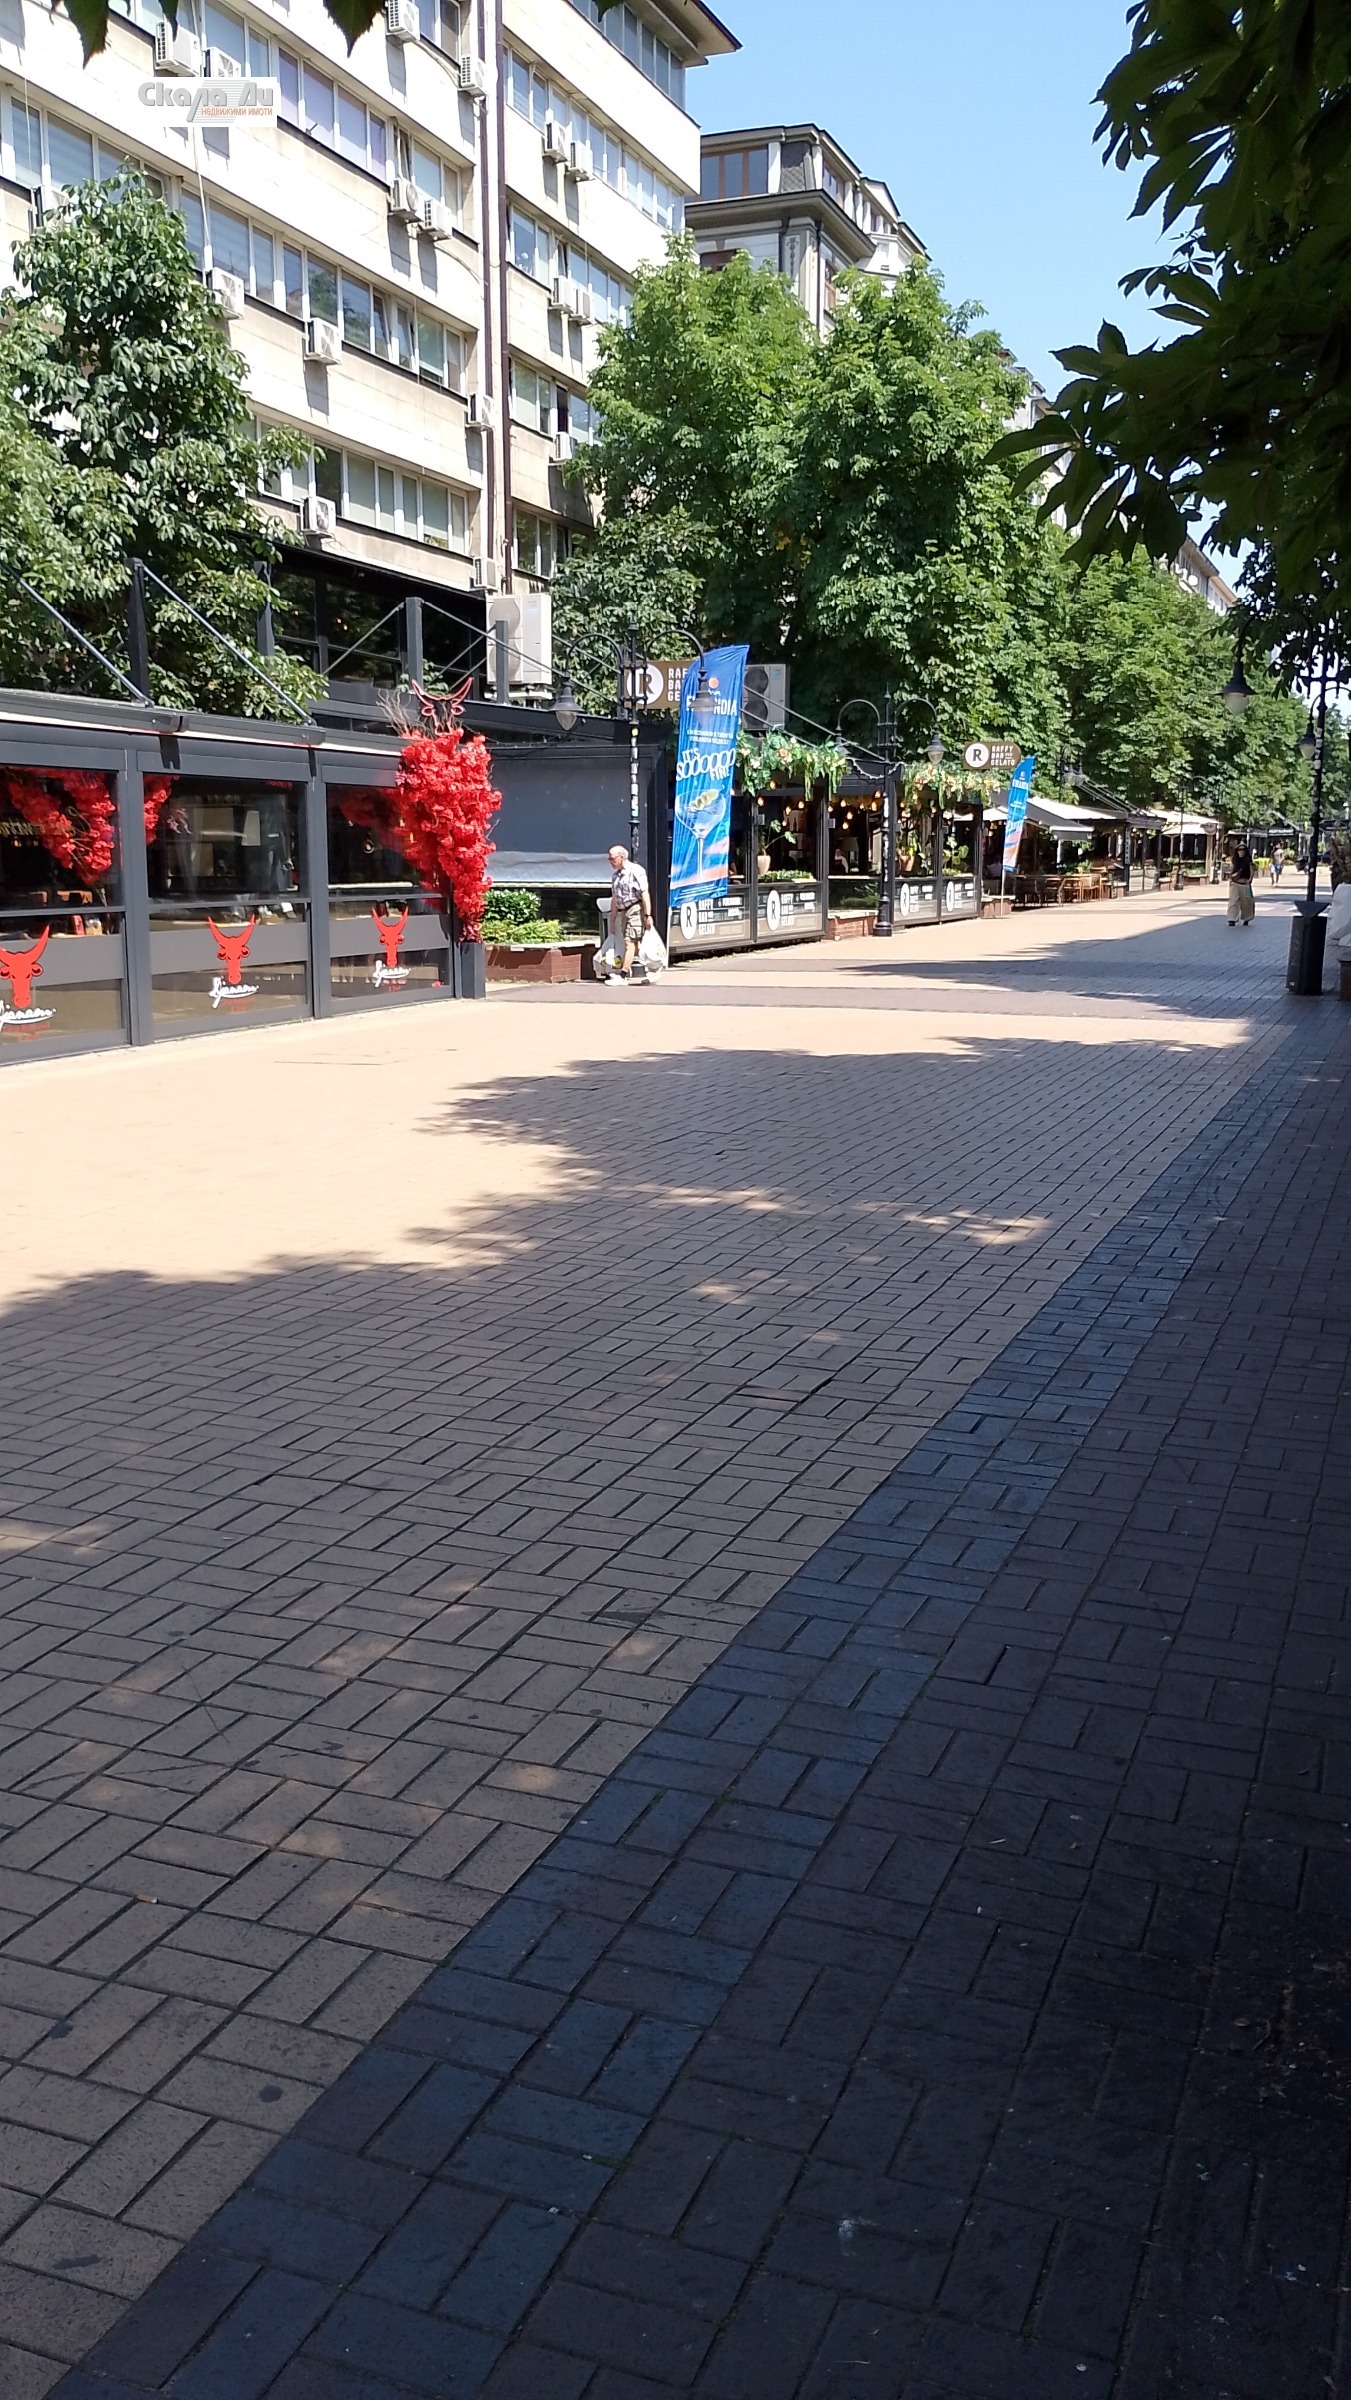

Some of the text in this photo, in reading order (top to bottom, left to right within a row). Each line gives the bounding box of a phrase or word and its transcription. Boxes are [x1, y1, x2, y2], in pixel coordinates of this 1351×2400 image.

[668, 668, 688, 679] RAF
[638, 673, 655, 695] R
[668, 680, 683, 691] BA
[991, 745, 1014, 753] RAFFY
[972, 749, 982, 761] R
[686, 906, 693, 927] R
